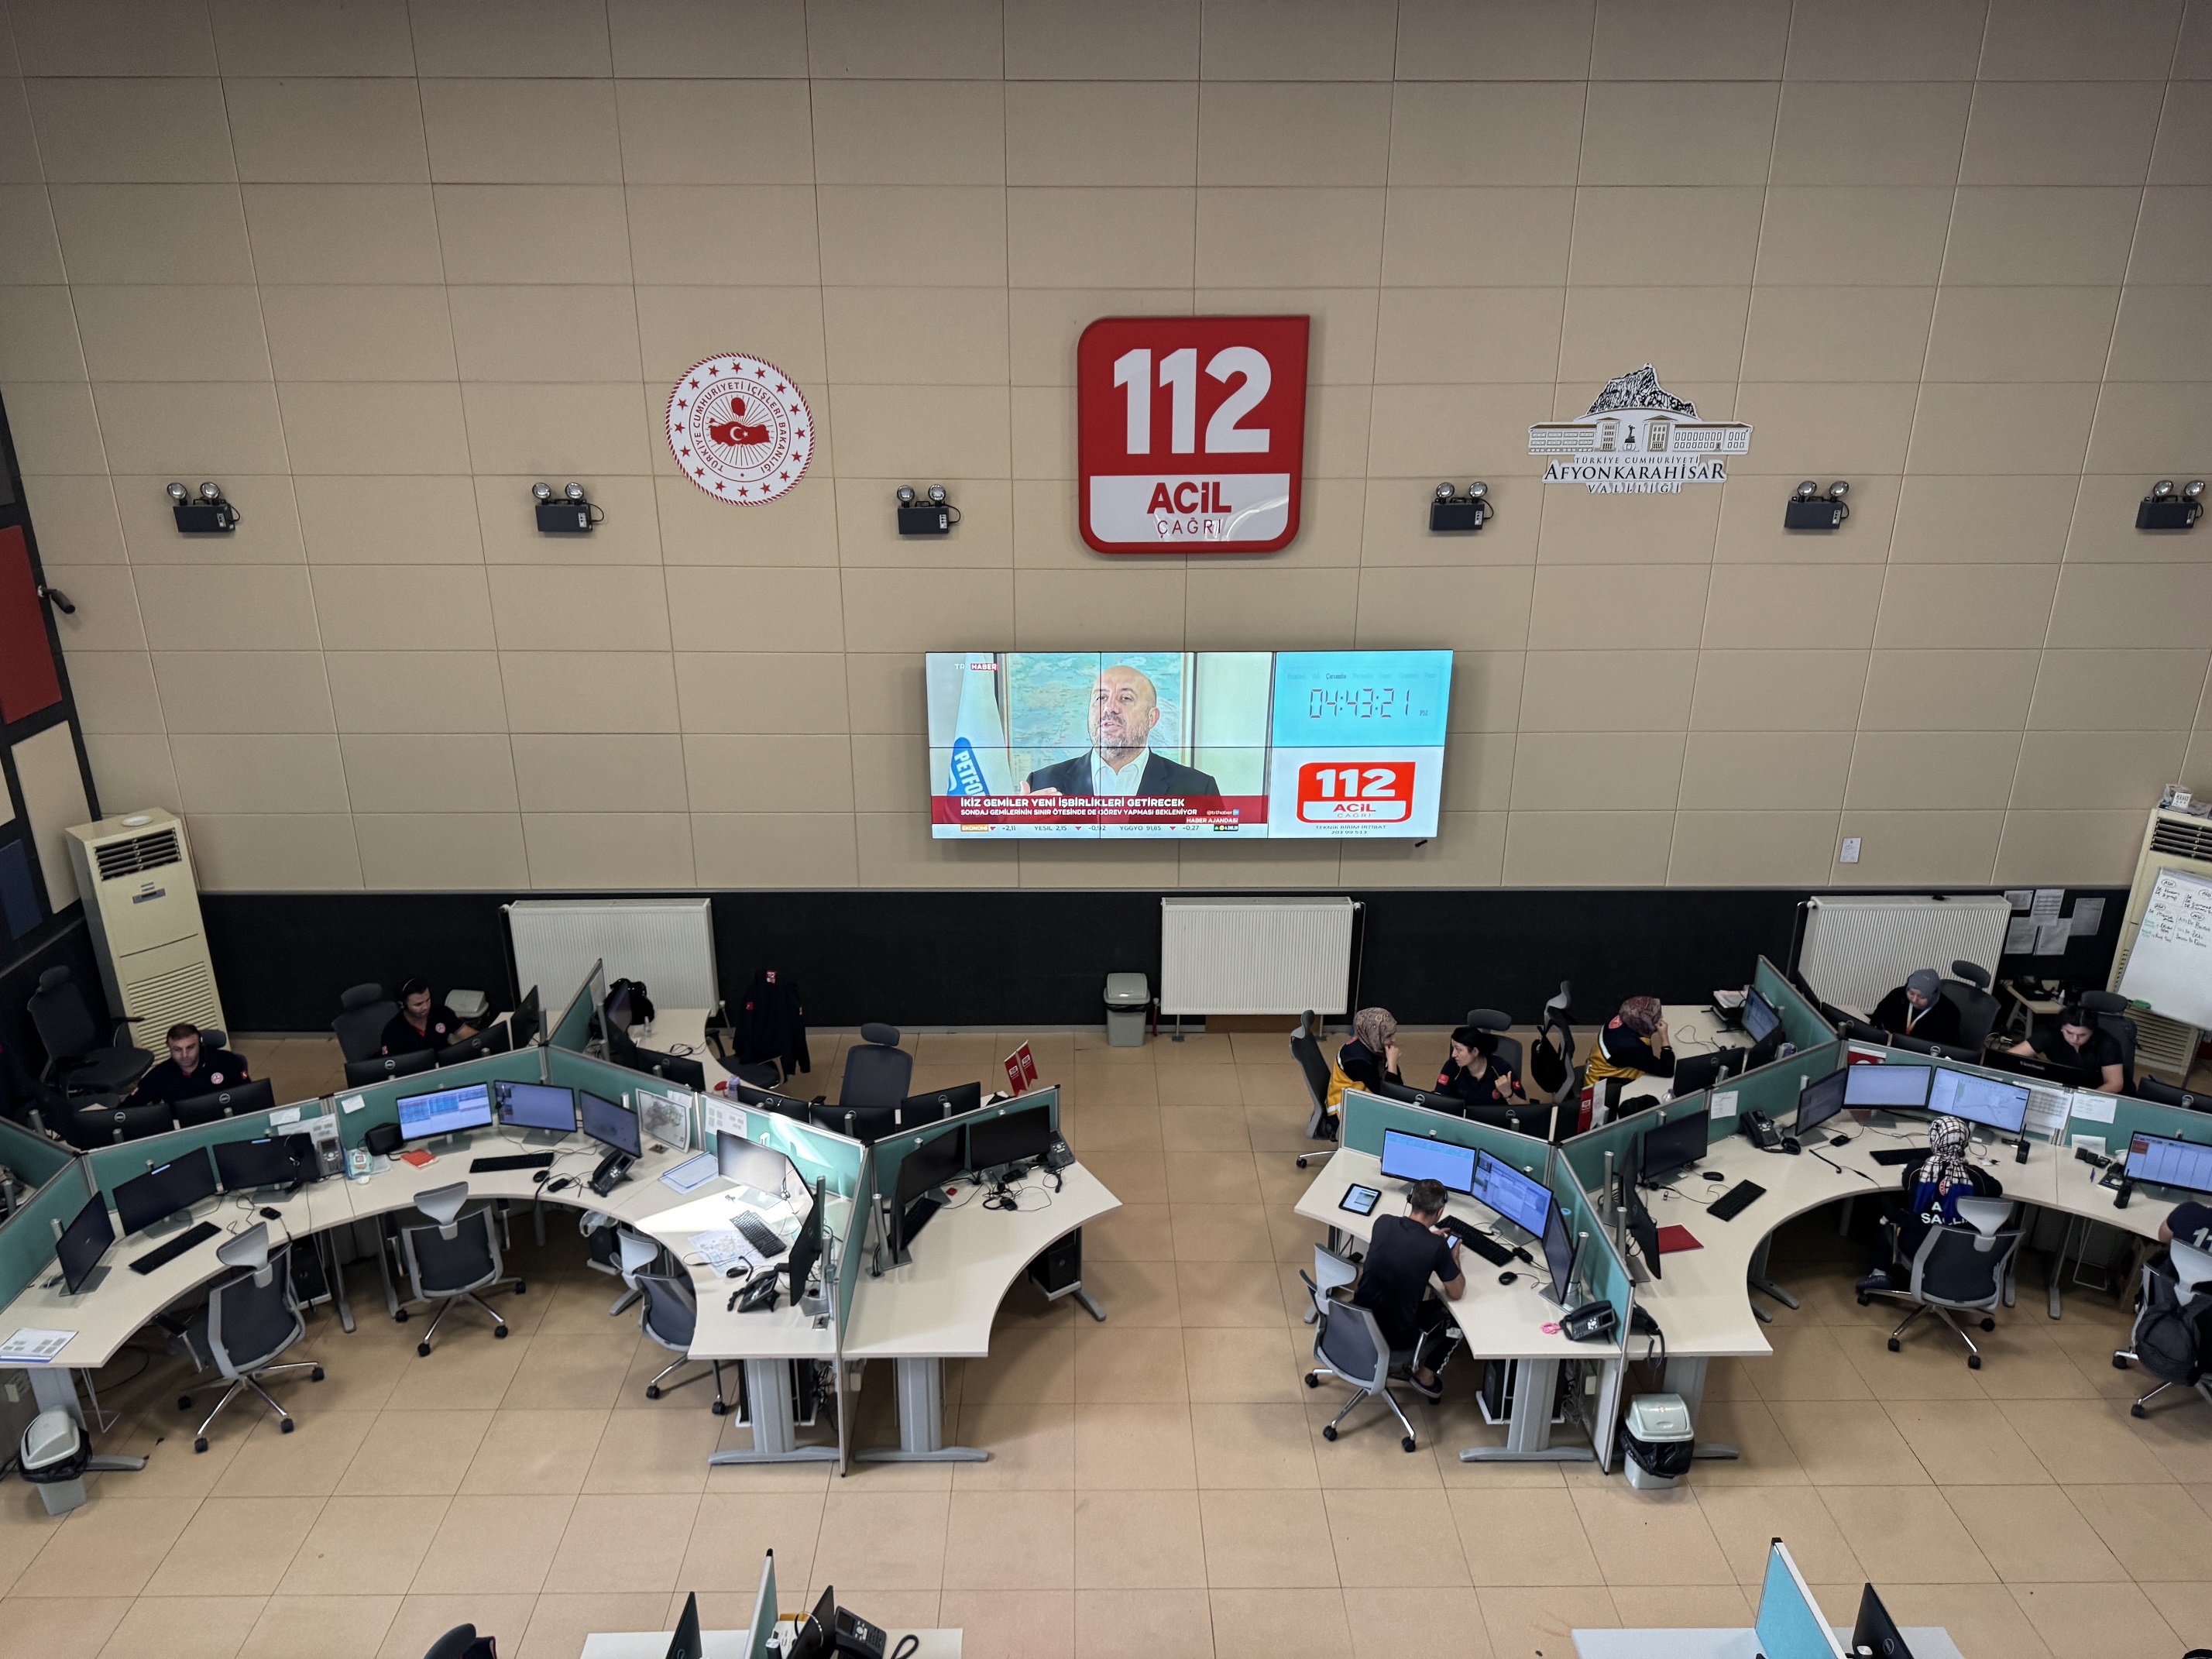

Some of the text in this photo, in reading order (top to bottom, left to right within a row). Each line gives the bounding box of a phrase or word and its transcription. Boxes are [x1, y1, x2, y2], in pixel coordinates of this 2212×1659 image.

[692, 381, 744, 428] CUMHURİYETİ
[747, 382, 785, 419] İÇİŞLERİ
[1114, 345, 1272, 455] 112
[761, 422, 787, 474] BAKANLIĞI
[1575, 455, 1699, 464] TÜRKİYE CUMHURİYETİ
[1544, 462, 1725, 480] AFYONKARAHİSAR
[1146, 481, 1232, 514] ACİL
[1157, 517, 1221, 538] ÇAĞRI
[1310, 688, 1410, 719] 04:43:21
[953, 750, 986, 796] PETFO
[1316, 768, 1396, 798] 112
[960, 797, 1185, 809] İKİZ GEMİLER YENİ İŞBİRLİKLERİ GETİRECEK
